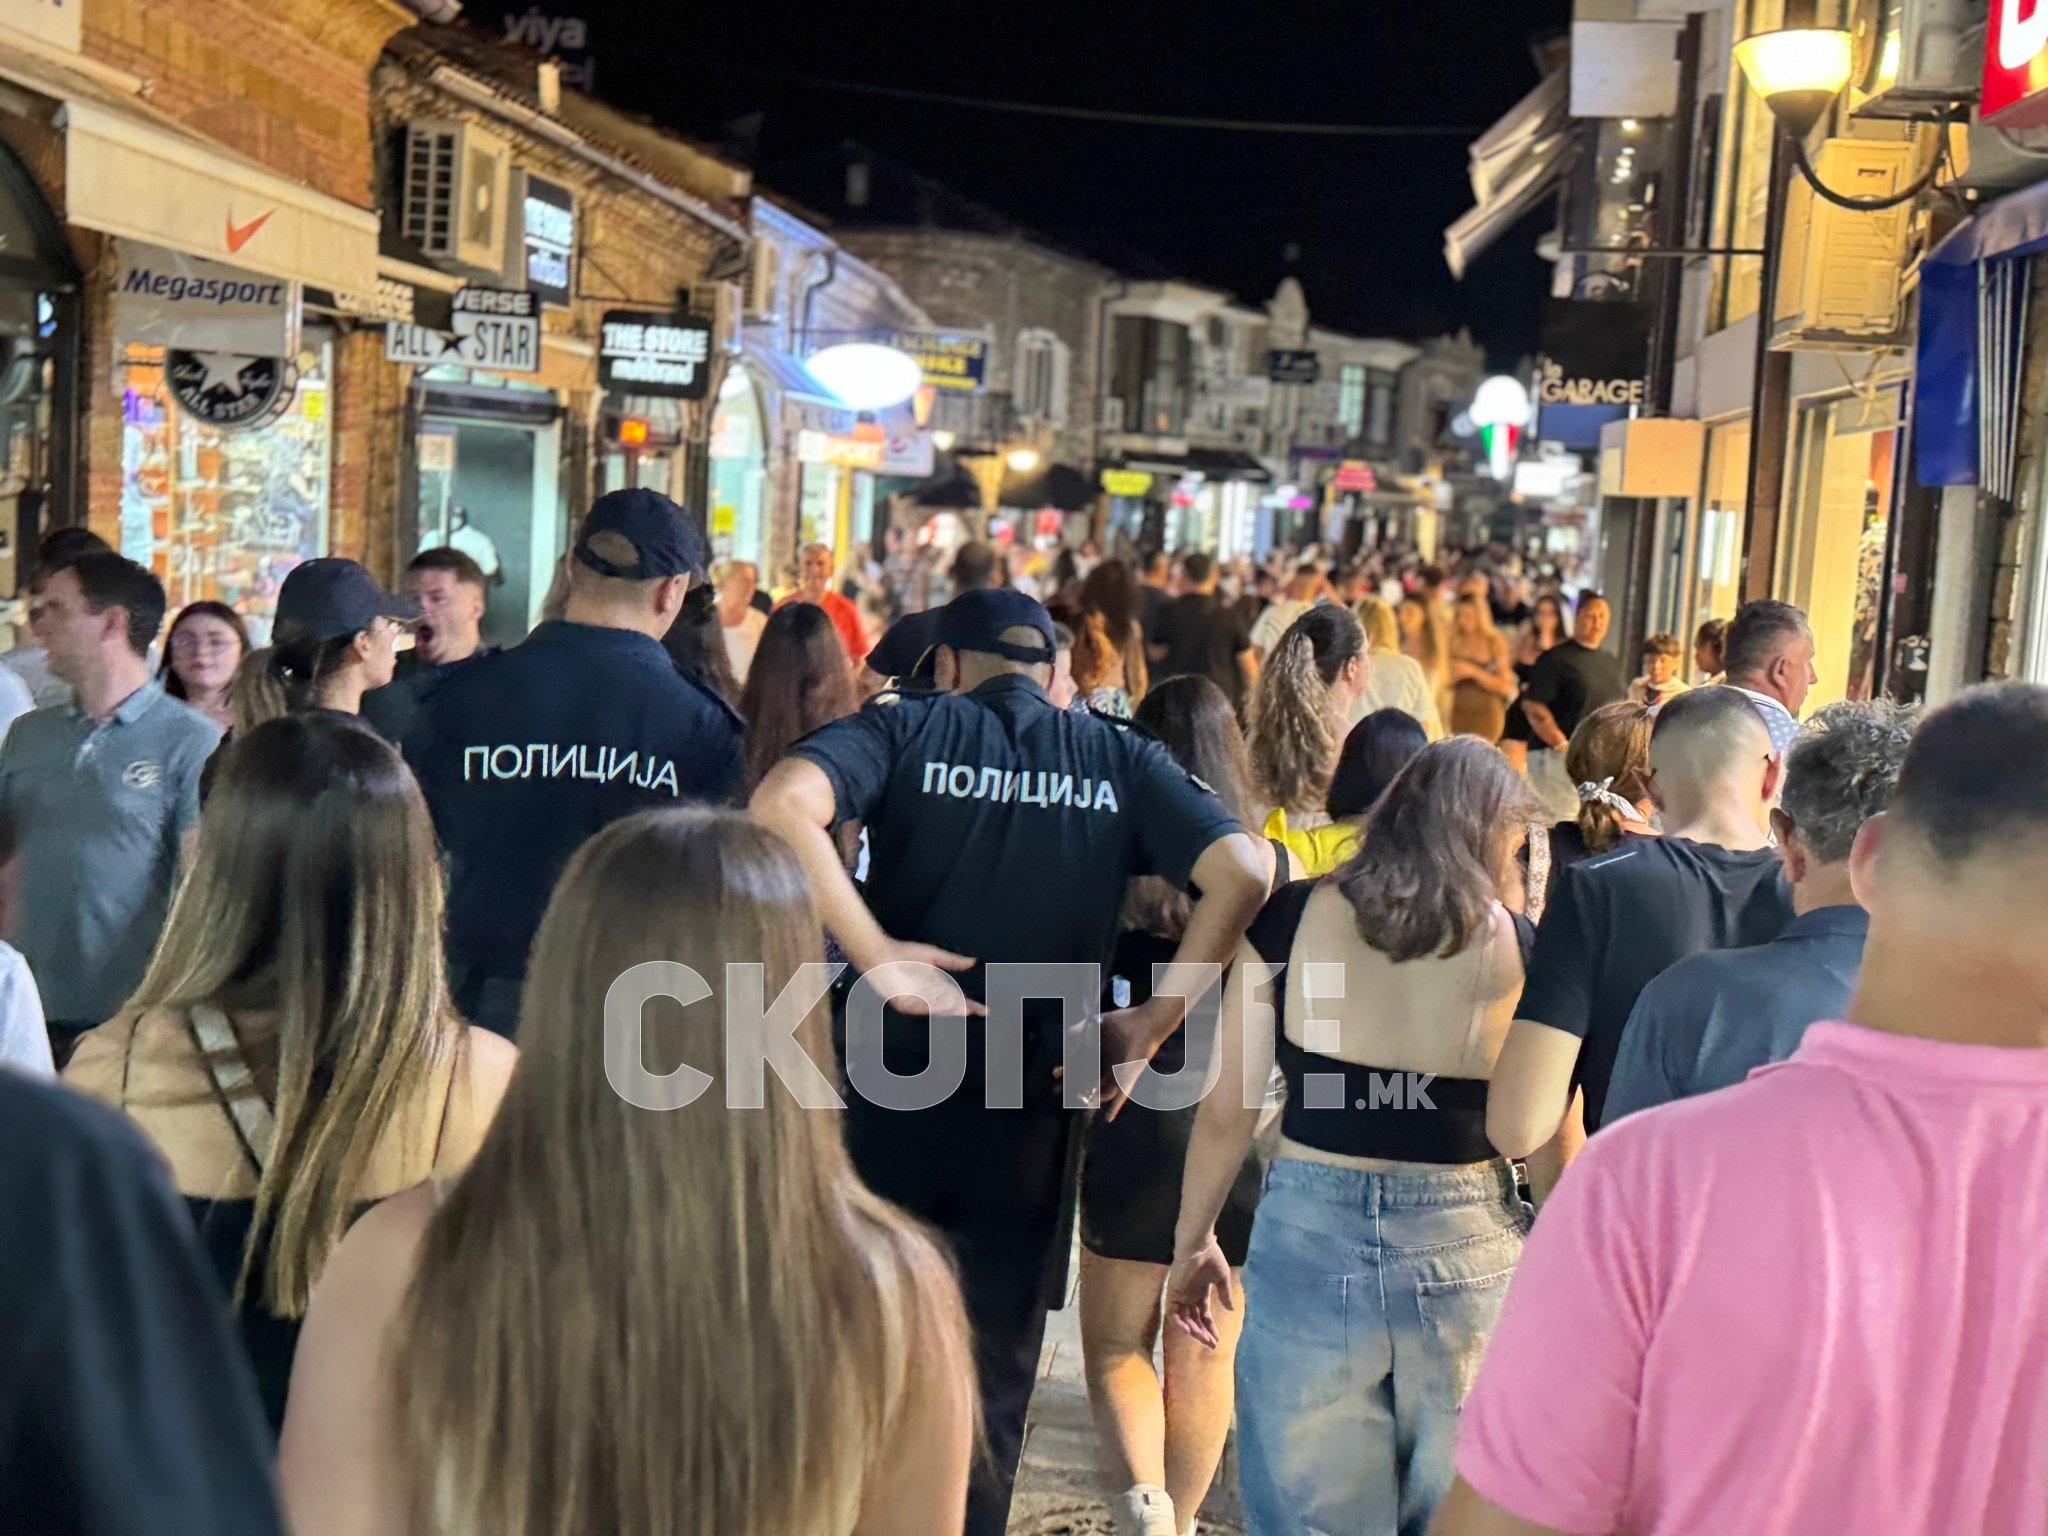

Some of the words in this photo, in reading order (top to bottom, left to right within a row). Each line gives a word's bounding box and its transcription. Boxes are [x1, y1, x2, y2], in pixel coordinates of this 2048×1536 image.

[124, 268, 284, 306] Megasport
[391, 326, 431, 356] ALL
[474, 320, 530, 366] STAR
[602, 323, 643, 349] THE
[643, 326, 708, 355] STORE
[1540, 378, 1644, 405] GARAGE
[464, 744, 680, 797] ПОЛИЦИЈА
[923, 761, 1119, 814] ПОЛИЦИЈА
